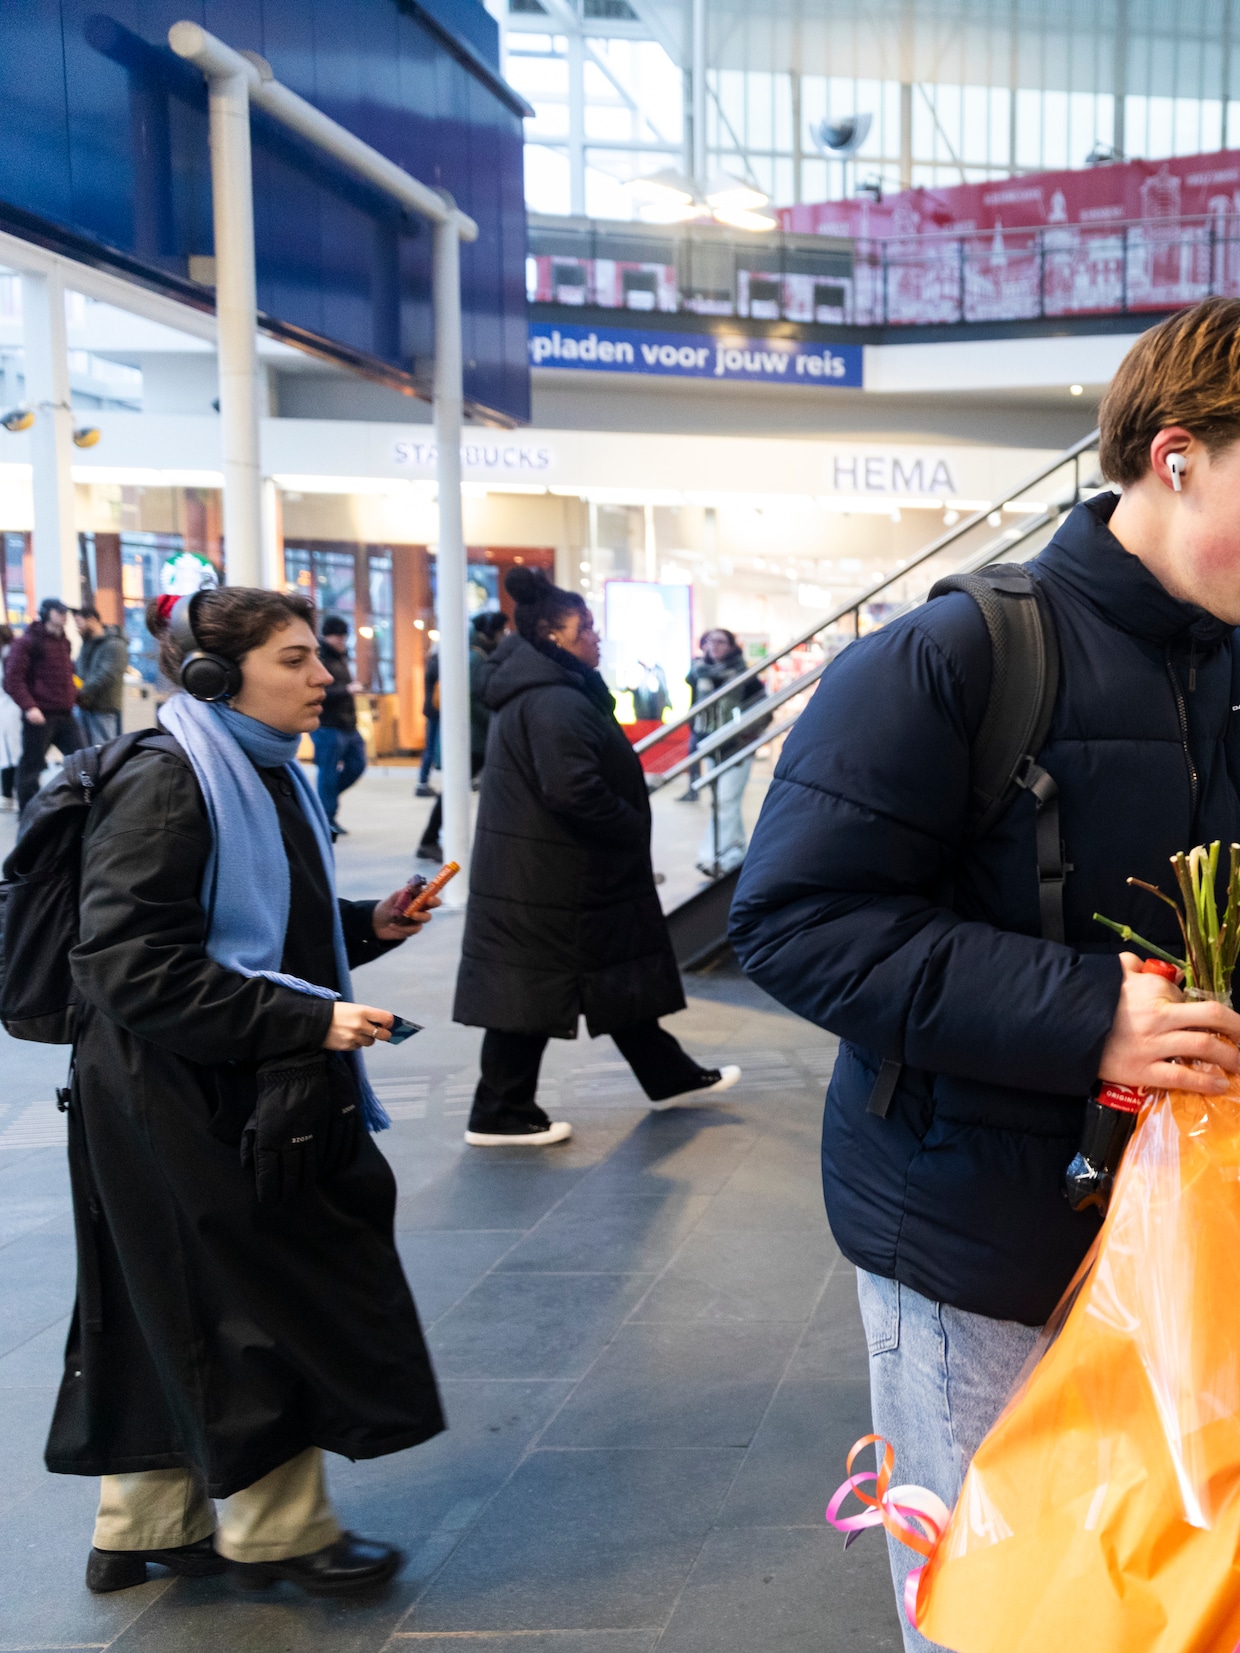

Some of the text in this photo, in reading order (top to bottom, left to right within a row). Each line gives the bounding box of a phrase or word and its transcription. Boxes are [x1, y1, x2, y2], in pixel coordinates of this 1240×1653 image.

[528, 331, 847, 379] pladen voor jouw reis
[395, 442, 551, 469] STABUCKS
[833, 455, 957, 494] HEMA
[1106, 1090, 1141, 1106] ORIGINAL
